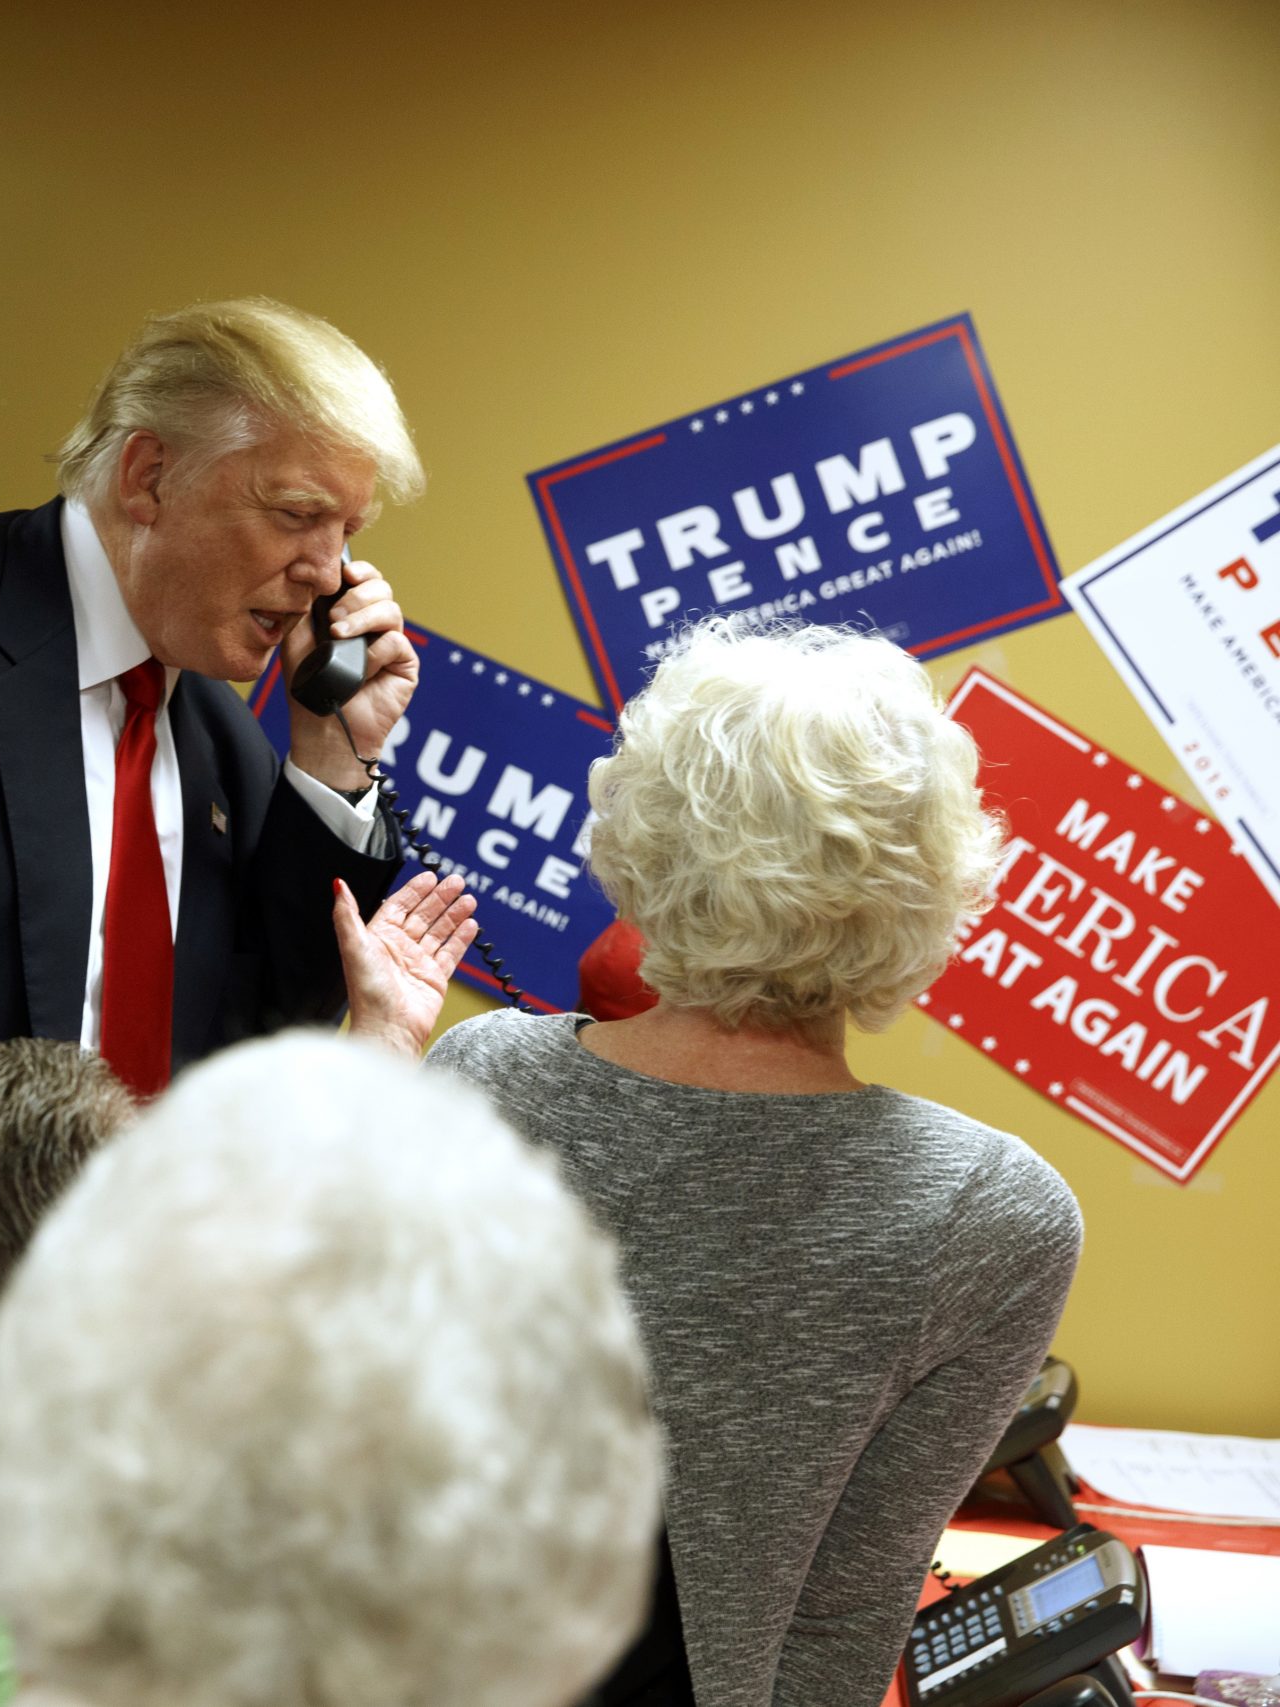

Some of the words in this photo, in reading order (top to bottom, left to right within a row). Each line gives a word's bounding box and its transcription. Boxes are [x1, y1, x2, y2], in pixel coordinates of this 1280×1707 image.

[585, 412, 977, 590] TRUMP
[639, 486, 960, 629] PENCE
[819, 560, 894, 600] GREAT
[900, 529, 984, 573] AGAIN!
[1179, 572, 1225, 632] MAKE
[1182, 740, 1231, 800] 2016
[1055, 798, 1205, 913] MAKE
[493, 886, 570, 933] AGAIN!
[1030, 975, 1210, 1105] AGAIN
